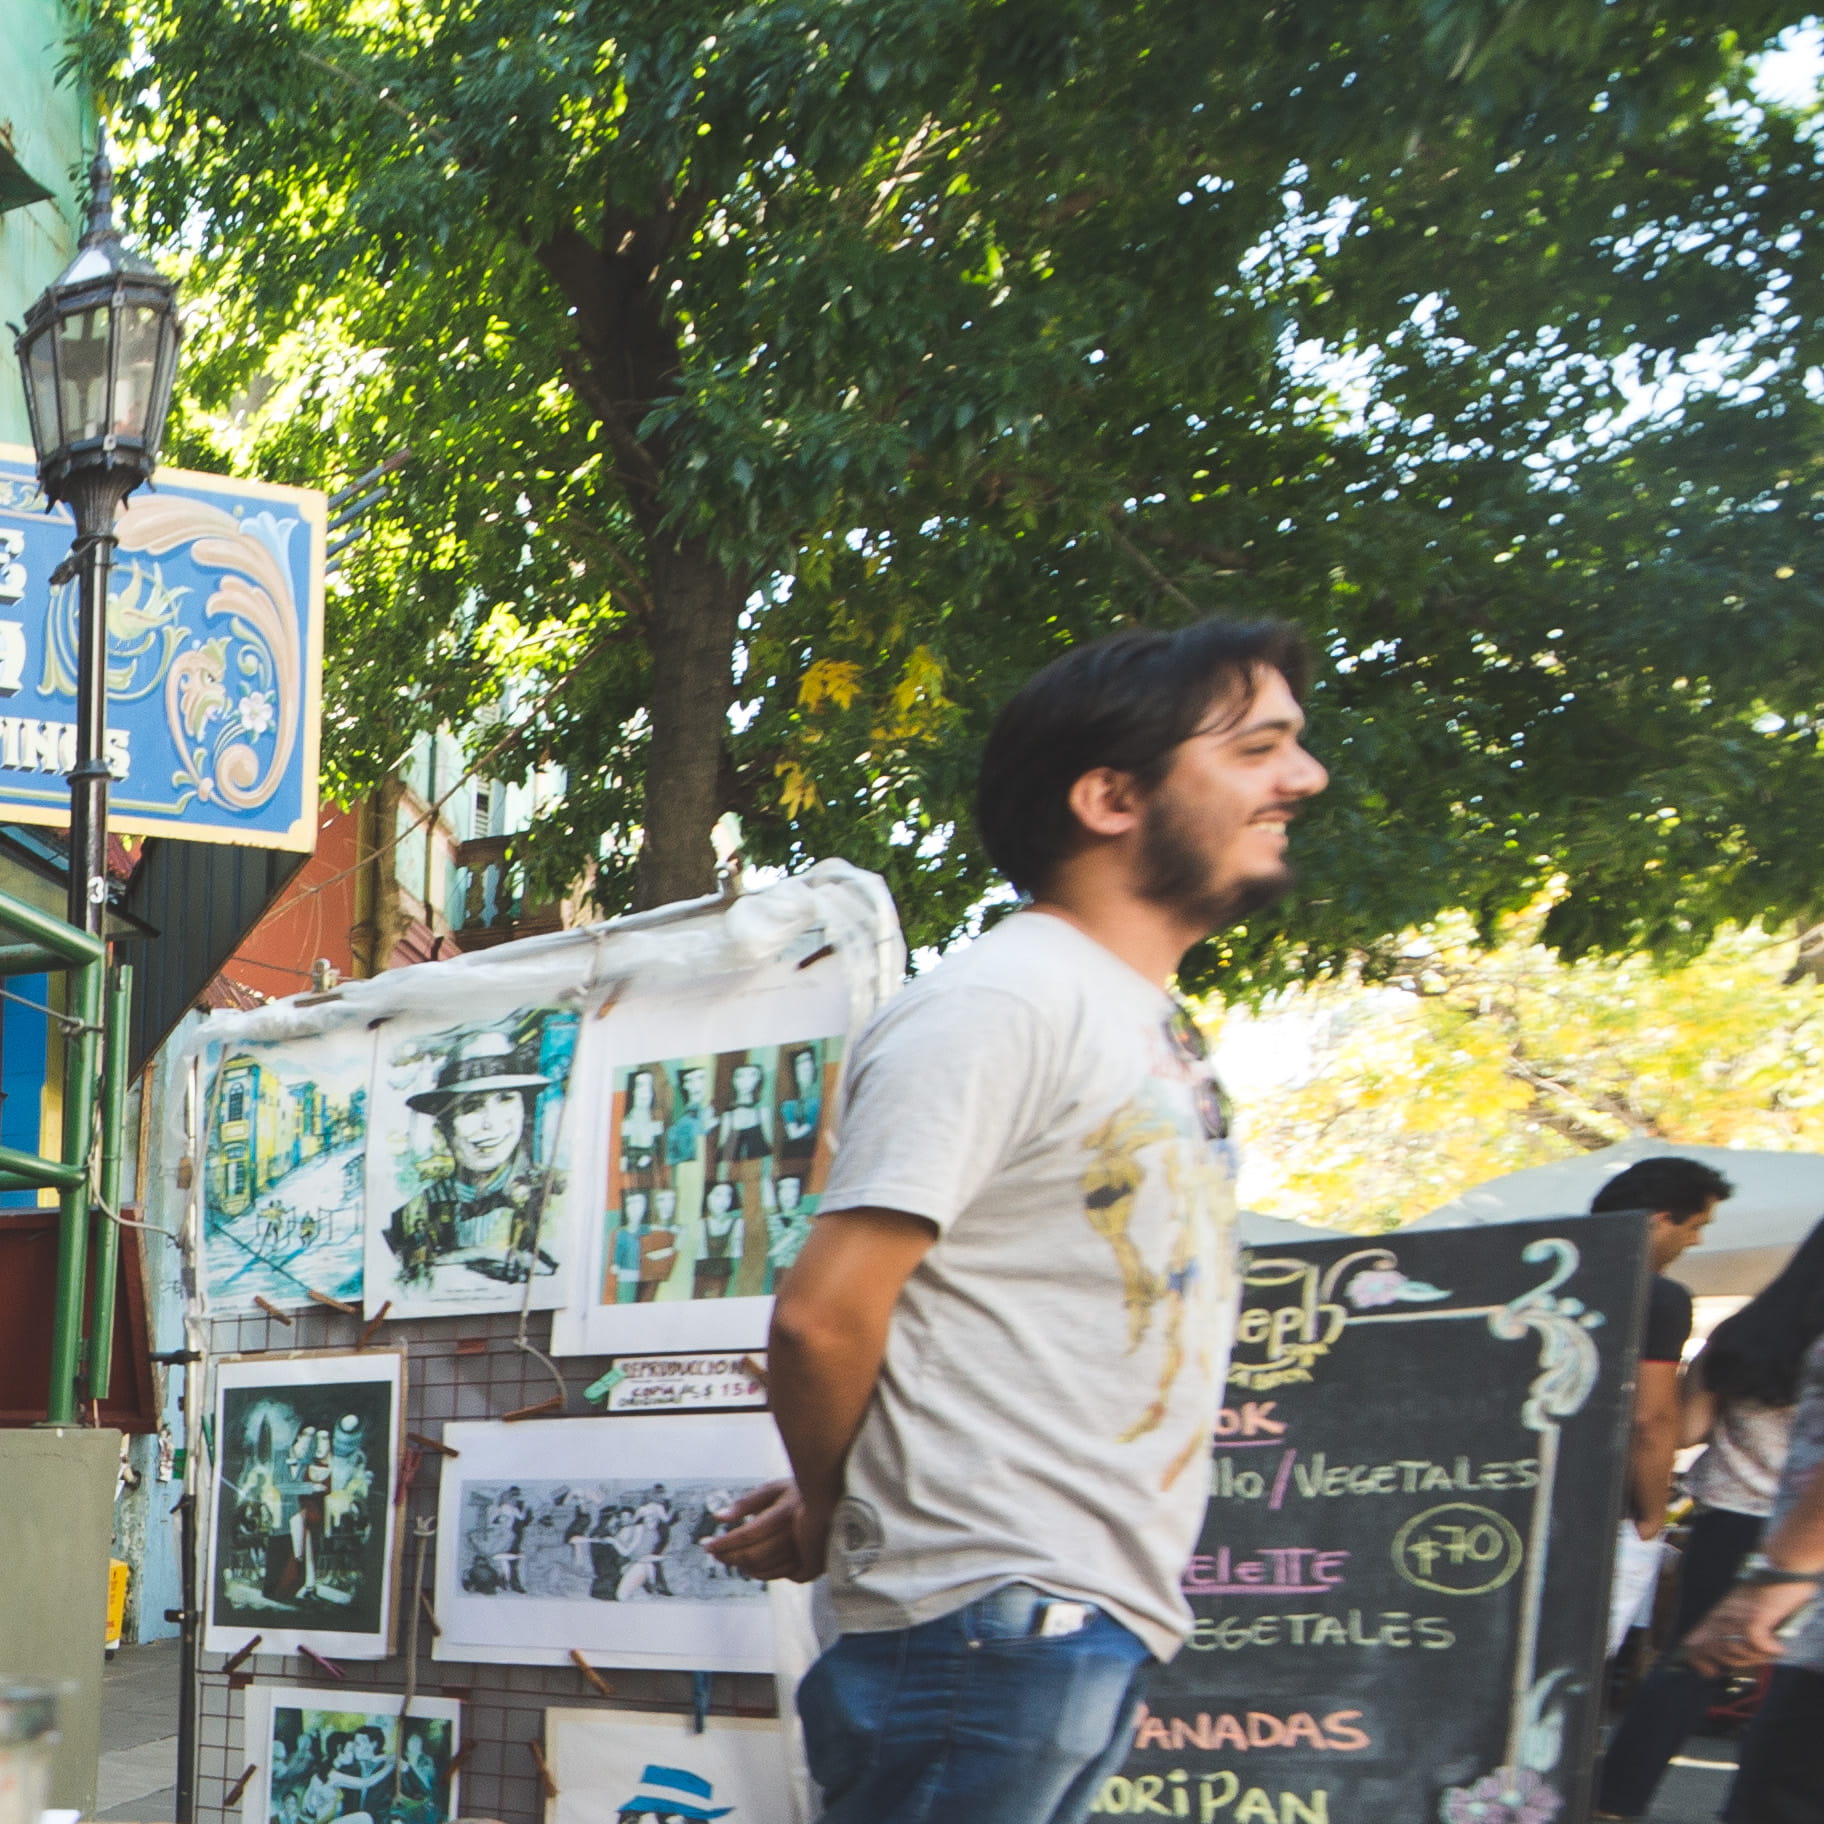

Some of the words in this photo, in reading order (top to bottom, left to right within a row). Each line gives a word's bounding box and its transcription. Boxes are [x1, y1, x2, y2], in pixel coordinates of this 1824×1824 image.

[87, 876, 105, 904] 3
[1186, 1609, 1457, 1651] EGETALES
[1133, 1702, 1371, 1751] ANADAS
